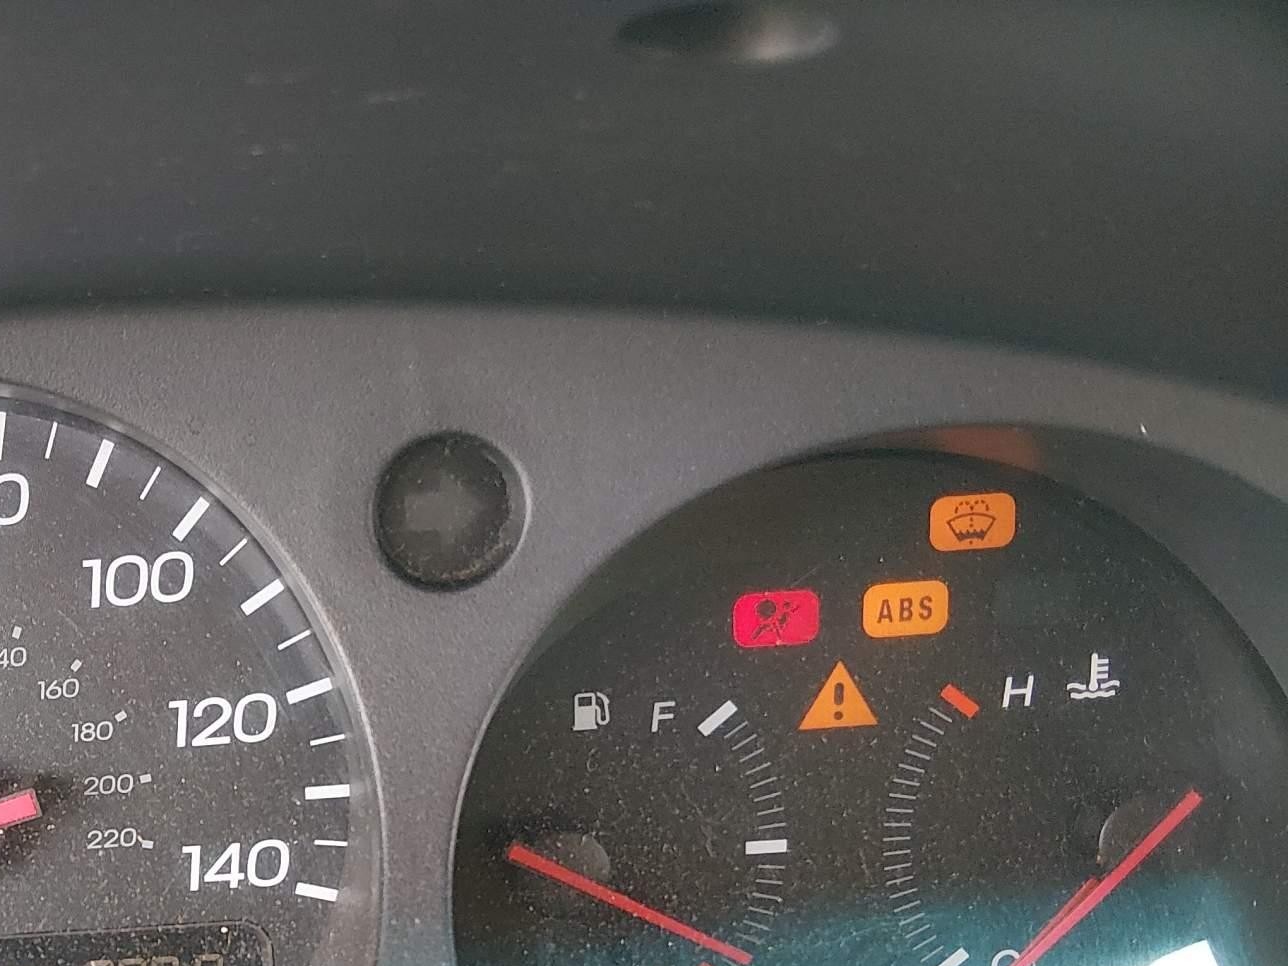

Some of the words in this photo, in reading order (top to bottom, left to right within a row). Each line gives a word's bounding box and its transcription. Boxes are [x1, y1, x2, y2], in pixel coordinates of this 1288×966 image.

[82, 550, 195, 609] 100
[876, 597, 934, 625] ABS
[37, 678, 80, 700] 160
[1001, 675, 1035, 708] H
[168, 693, 278, 748] 120
[650, 701, 677, 732] F
[71, 721, 114, 743] 180
[83, 774, 134, 797] 200
[86, 827, 138, 850] 220
[180, 839, 291, 893] 140
